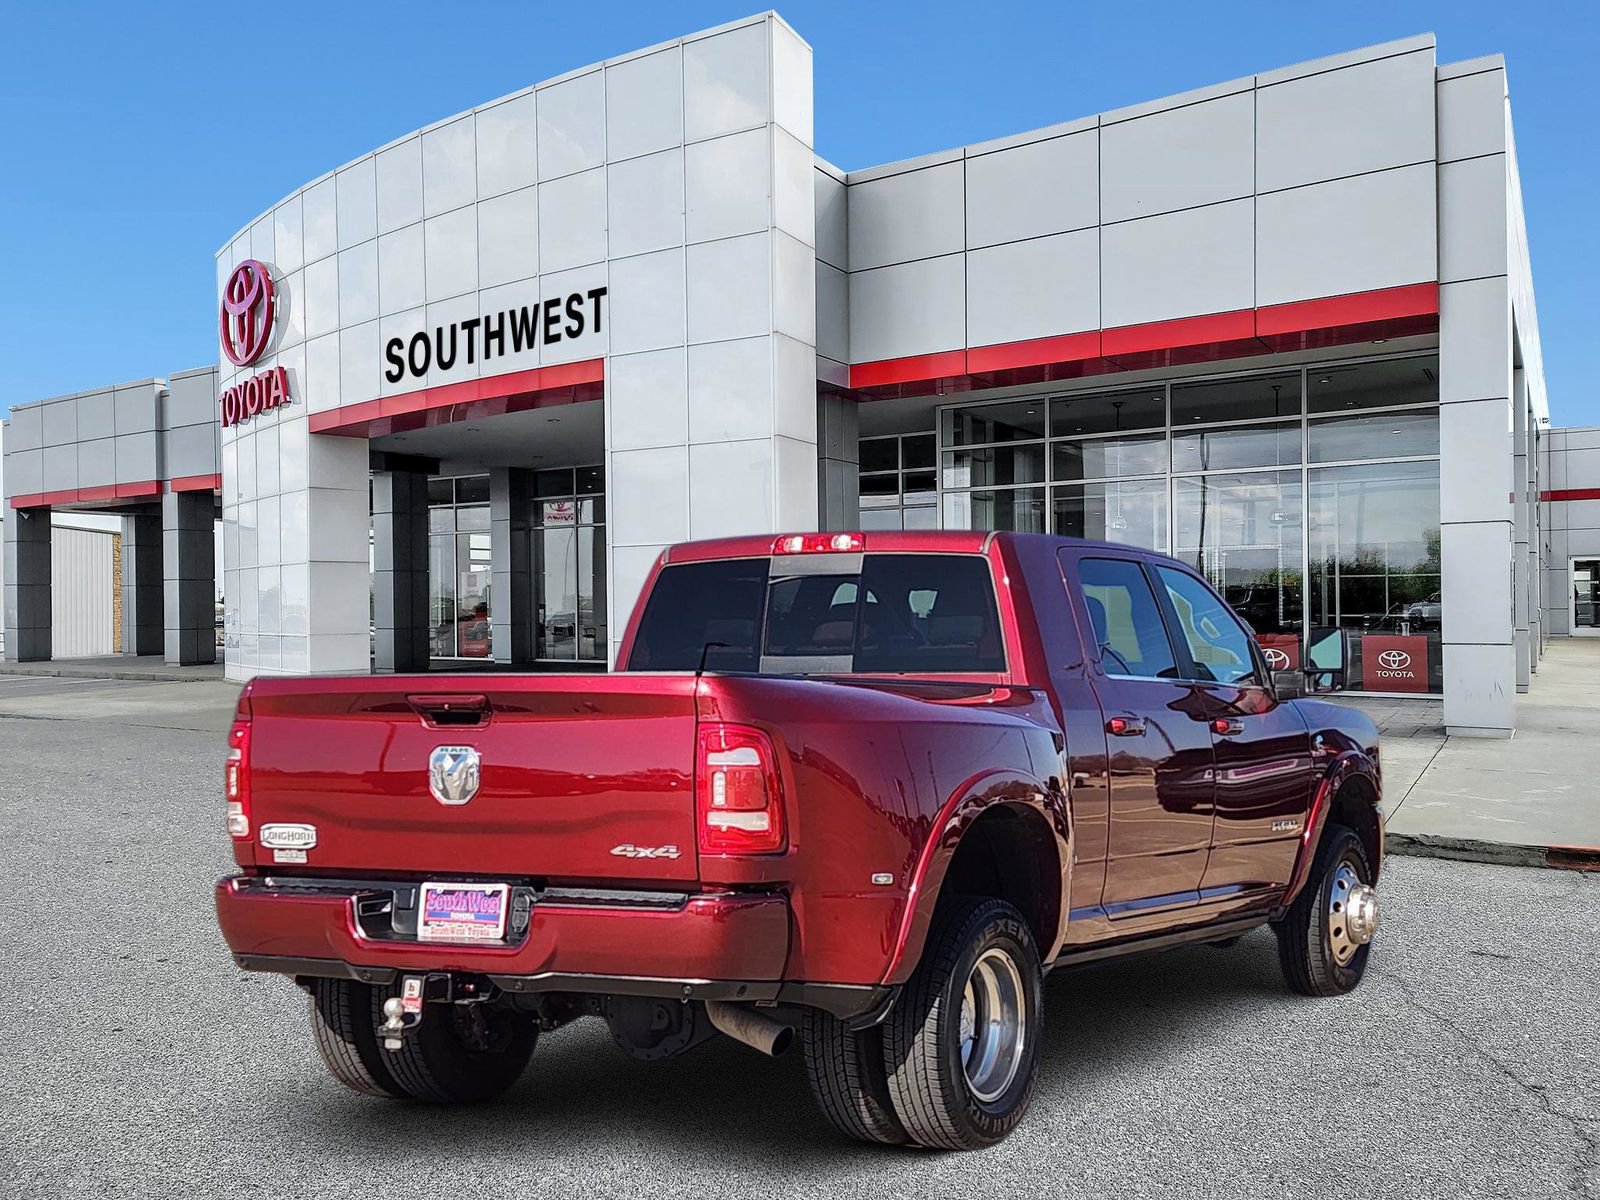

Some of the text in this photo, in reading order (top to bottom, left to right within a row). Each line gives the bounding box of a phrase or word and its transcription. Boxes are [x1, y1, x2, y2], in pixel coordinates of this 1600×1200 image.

[385, 286, 608, 384] SOUTHWEST
[218, 366, 290, 428] TOYOTA
[1375, 670, 1415, 679] TOYOTA
